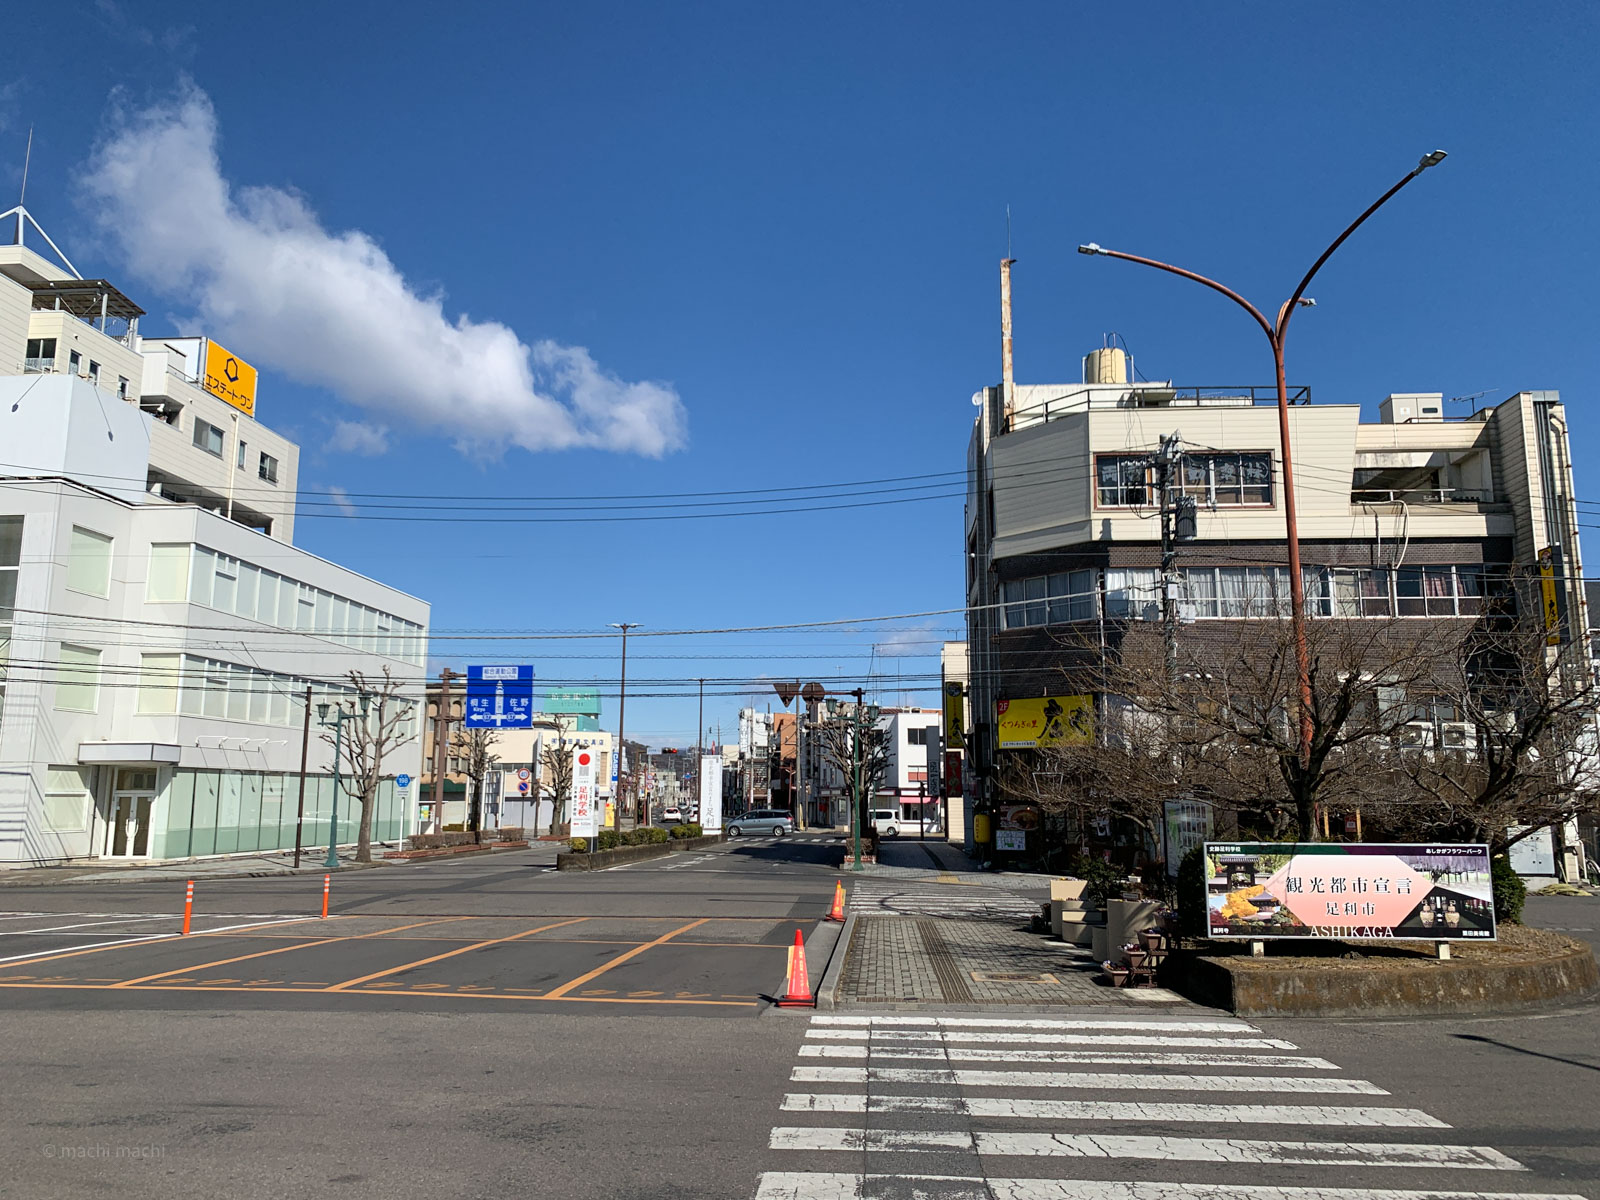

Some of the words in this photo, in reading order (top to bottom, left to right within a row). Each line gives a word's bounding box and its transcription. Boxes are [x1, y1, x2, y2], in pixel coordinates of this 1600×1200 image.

[470, 698, 489, 707] 桐生
[510, 698, 529, 707] 佐野
[999, 703, 1008, 711] 2F
[578, 786, 588, 817] 足利学校
[1286, 877, 1412, 894] 観光都市宣言
[1326, 902, 1375, 916] 足利市
[1310, 926, 1394, 937] ASHIKAGA
